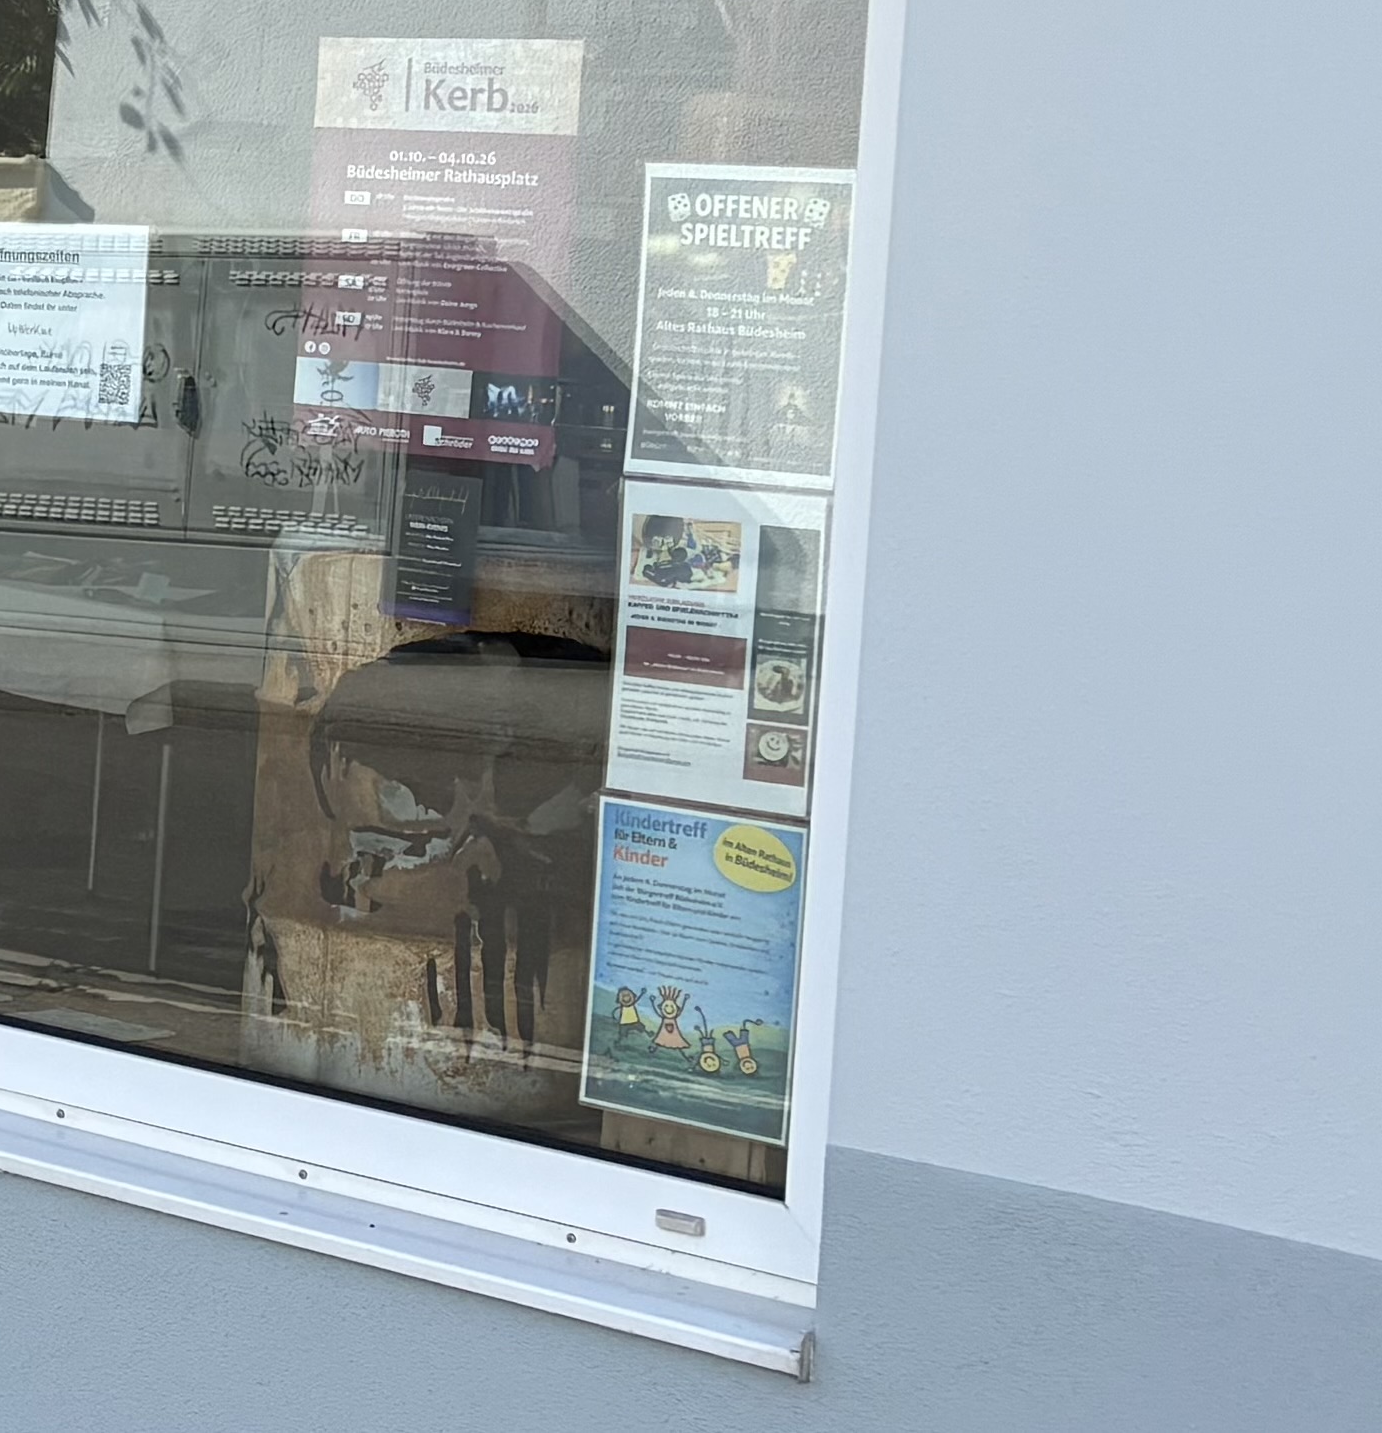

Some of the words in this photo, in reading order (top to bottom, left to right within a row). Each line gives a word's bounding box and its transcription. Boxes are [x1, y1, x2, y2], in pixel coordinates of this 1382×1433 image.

[424, 62, 505, 76] Büdesheimer
[424, 78, 509, 113] Kerb
[389, 150, 426, 163] 01.10.
[438, 151, 497, 167] 04.10.26
[346, 164, 440, 183] Büdesheimer
[444, 169, 539, 188] Rathausplatz
[695, 193, 798, 220] OFFENER
[680, 223, 812, 250] SPIELTREFF
[700, 289, 759, 304] Donnerstag
[745, 308, 766, 320] Uhr
[657, 320, 685, 332] Altes
[688, 322, 735, 335] Rathaus
[738, 324, 805, 339] Büdesheim
[615, 809, 708, 839] Kindertreff
[632, 831, 666, 848] Eltern
[668, 837, 678, 850] &
[613, 843, 669, 868] Kinder
